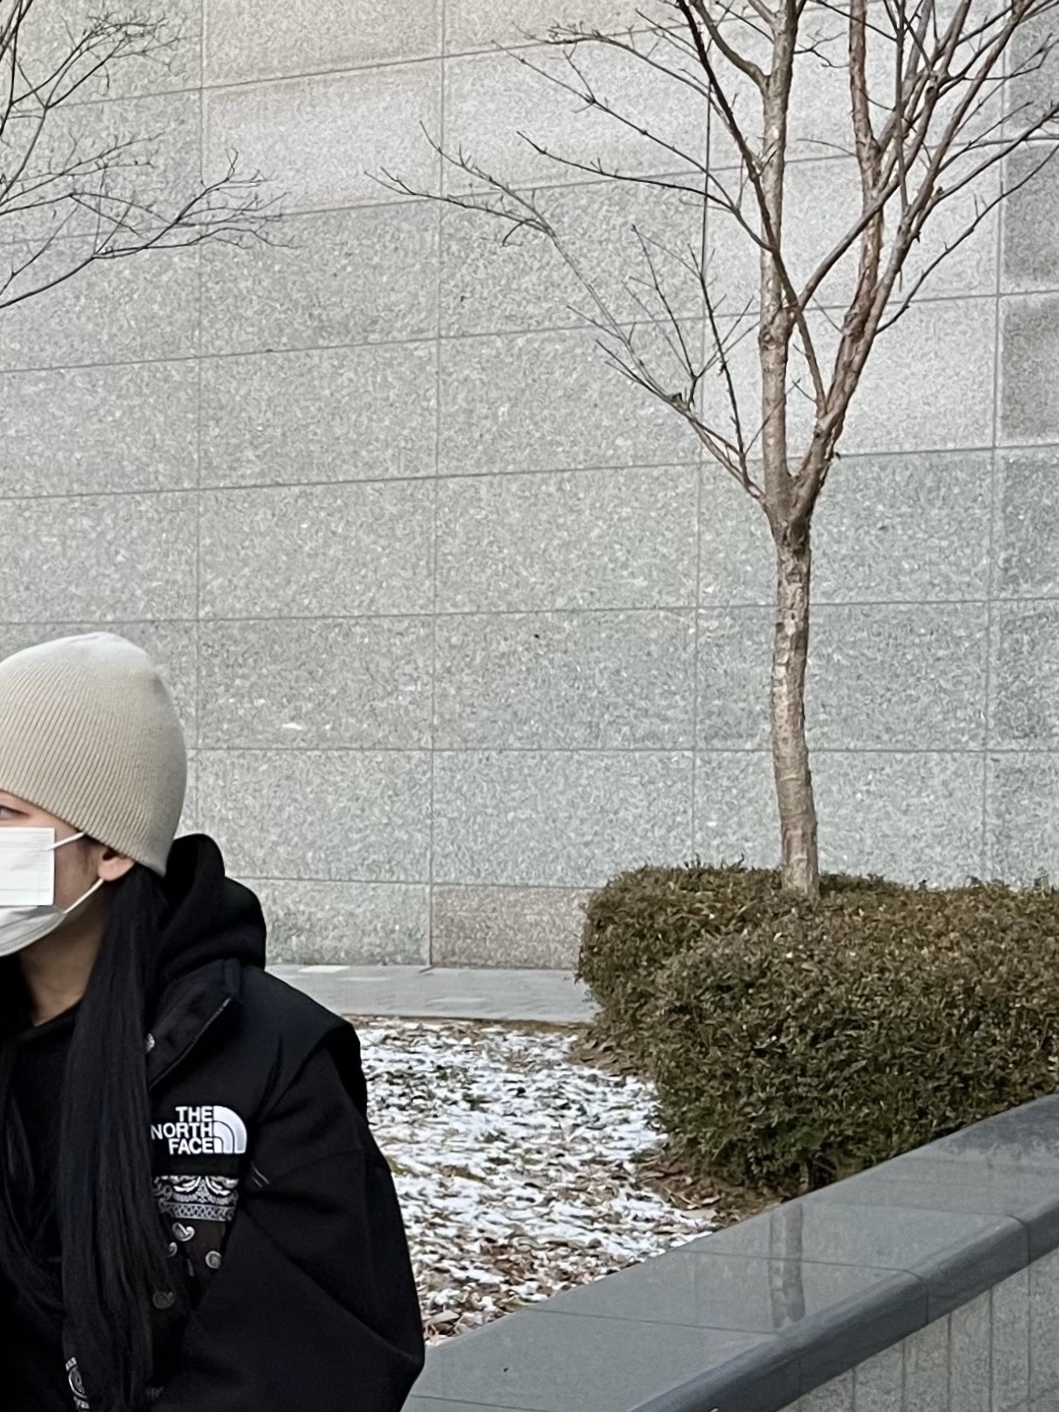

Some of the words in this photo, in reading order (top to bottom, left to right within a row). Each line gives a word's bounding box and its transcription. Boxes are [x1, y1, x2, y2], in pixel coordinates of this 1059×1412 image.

[175, 1106, 213, 1122] THE
[150, 1122, 212, 1140] NORTH
[168, 1138, 214, 1155] FACE
